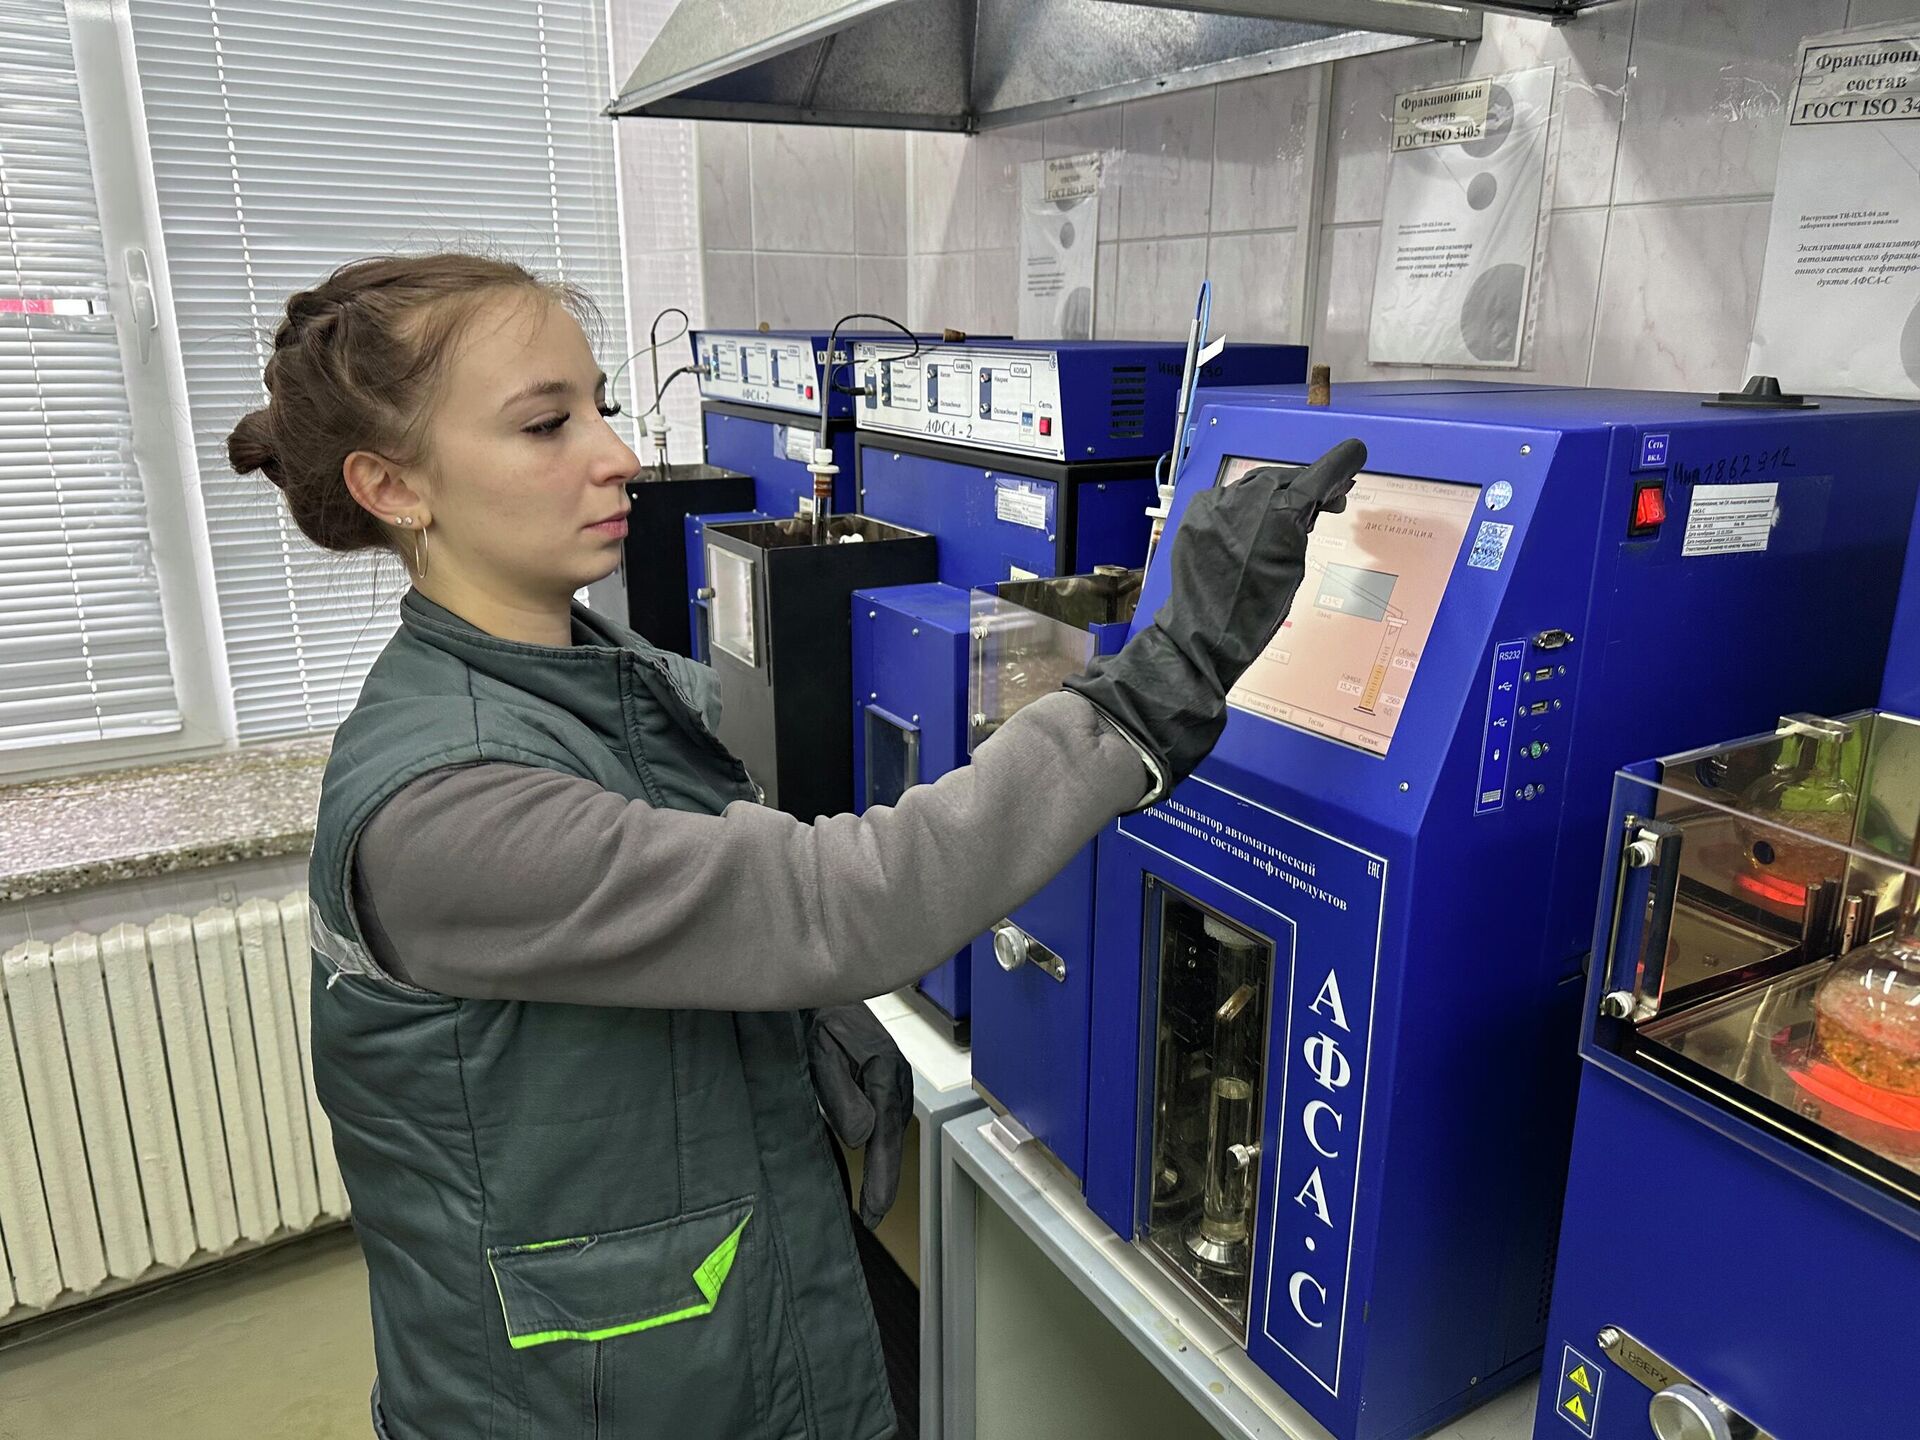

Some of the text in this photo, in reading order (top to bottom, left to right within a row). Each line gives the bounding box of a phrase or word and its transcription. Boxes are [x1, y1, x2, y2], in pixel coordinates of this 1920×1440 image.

[1846, 76, 1908, 91] состав
[1401, 86, 1482, 112] Фракционный
[1801, 101, 1858, 119] ГОСТ
[1861, 98, 1897, 116] ISO
[1421, 111, 1456, 124] состав
[1397, 125, 1481, 148] ГОСТ ISO 3405
[1797, 243, 1862, 253] Эксплуатация
[1797, 254, 1879, 264] автоматического
[1826, 266, 1863, 274] состава
[1816, 275, 1895, 288] дуктов АФСА-С
[1038, 400, 1053, 409] Сеть
[924, 418, 956, 437] АФСА
[1647, 440, 1664, 449] Сеть
[1386, 513, 1420, 525] СТАТУС
[1364, 522, 1434, 539] ДИСТИЛЛЯЦИЯ
[1499, 650, 1520, 661] RS232
[1165, 798, 1316, 878] Анализатор автоматический
[1210, 835, 1250, 862] состава
[1253, 856, 1348, 912] нефтепродуктов
[1366, 860, 1381, 879] EAC
[1628, 1351, 1669, 1386] ВВЕРХ
